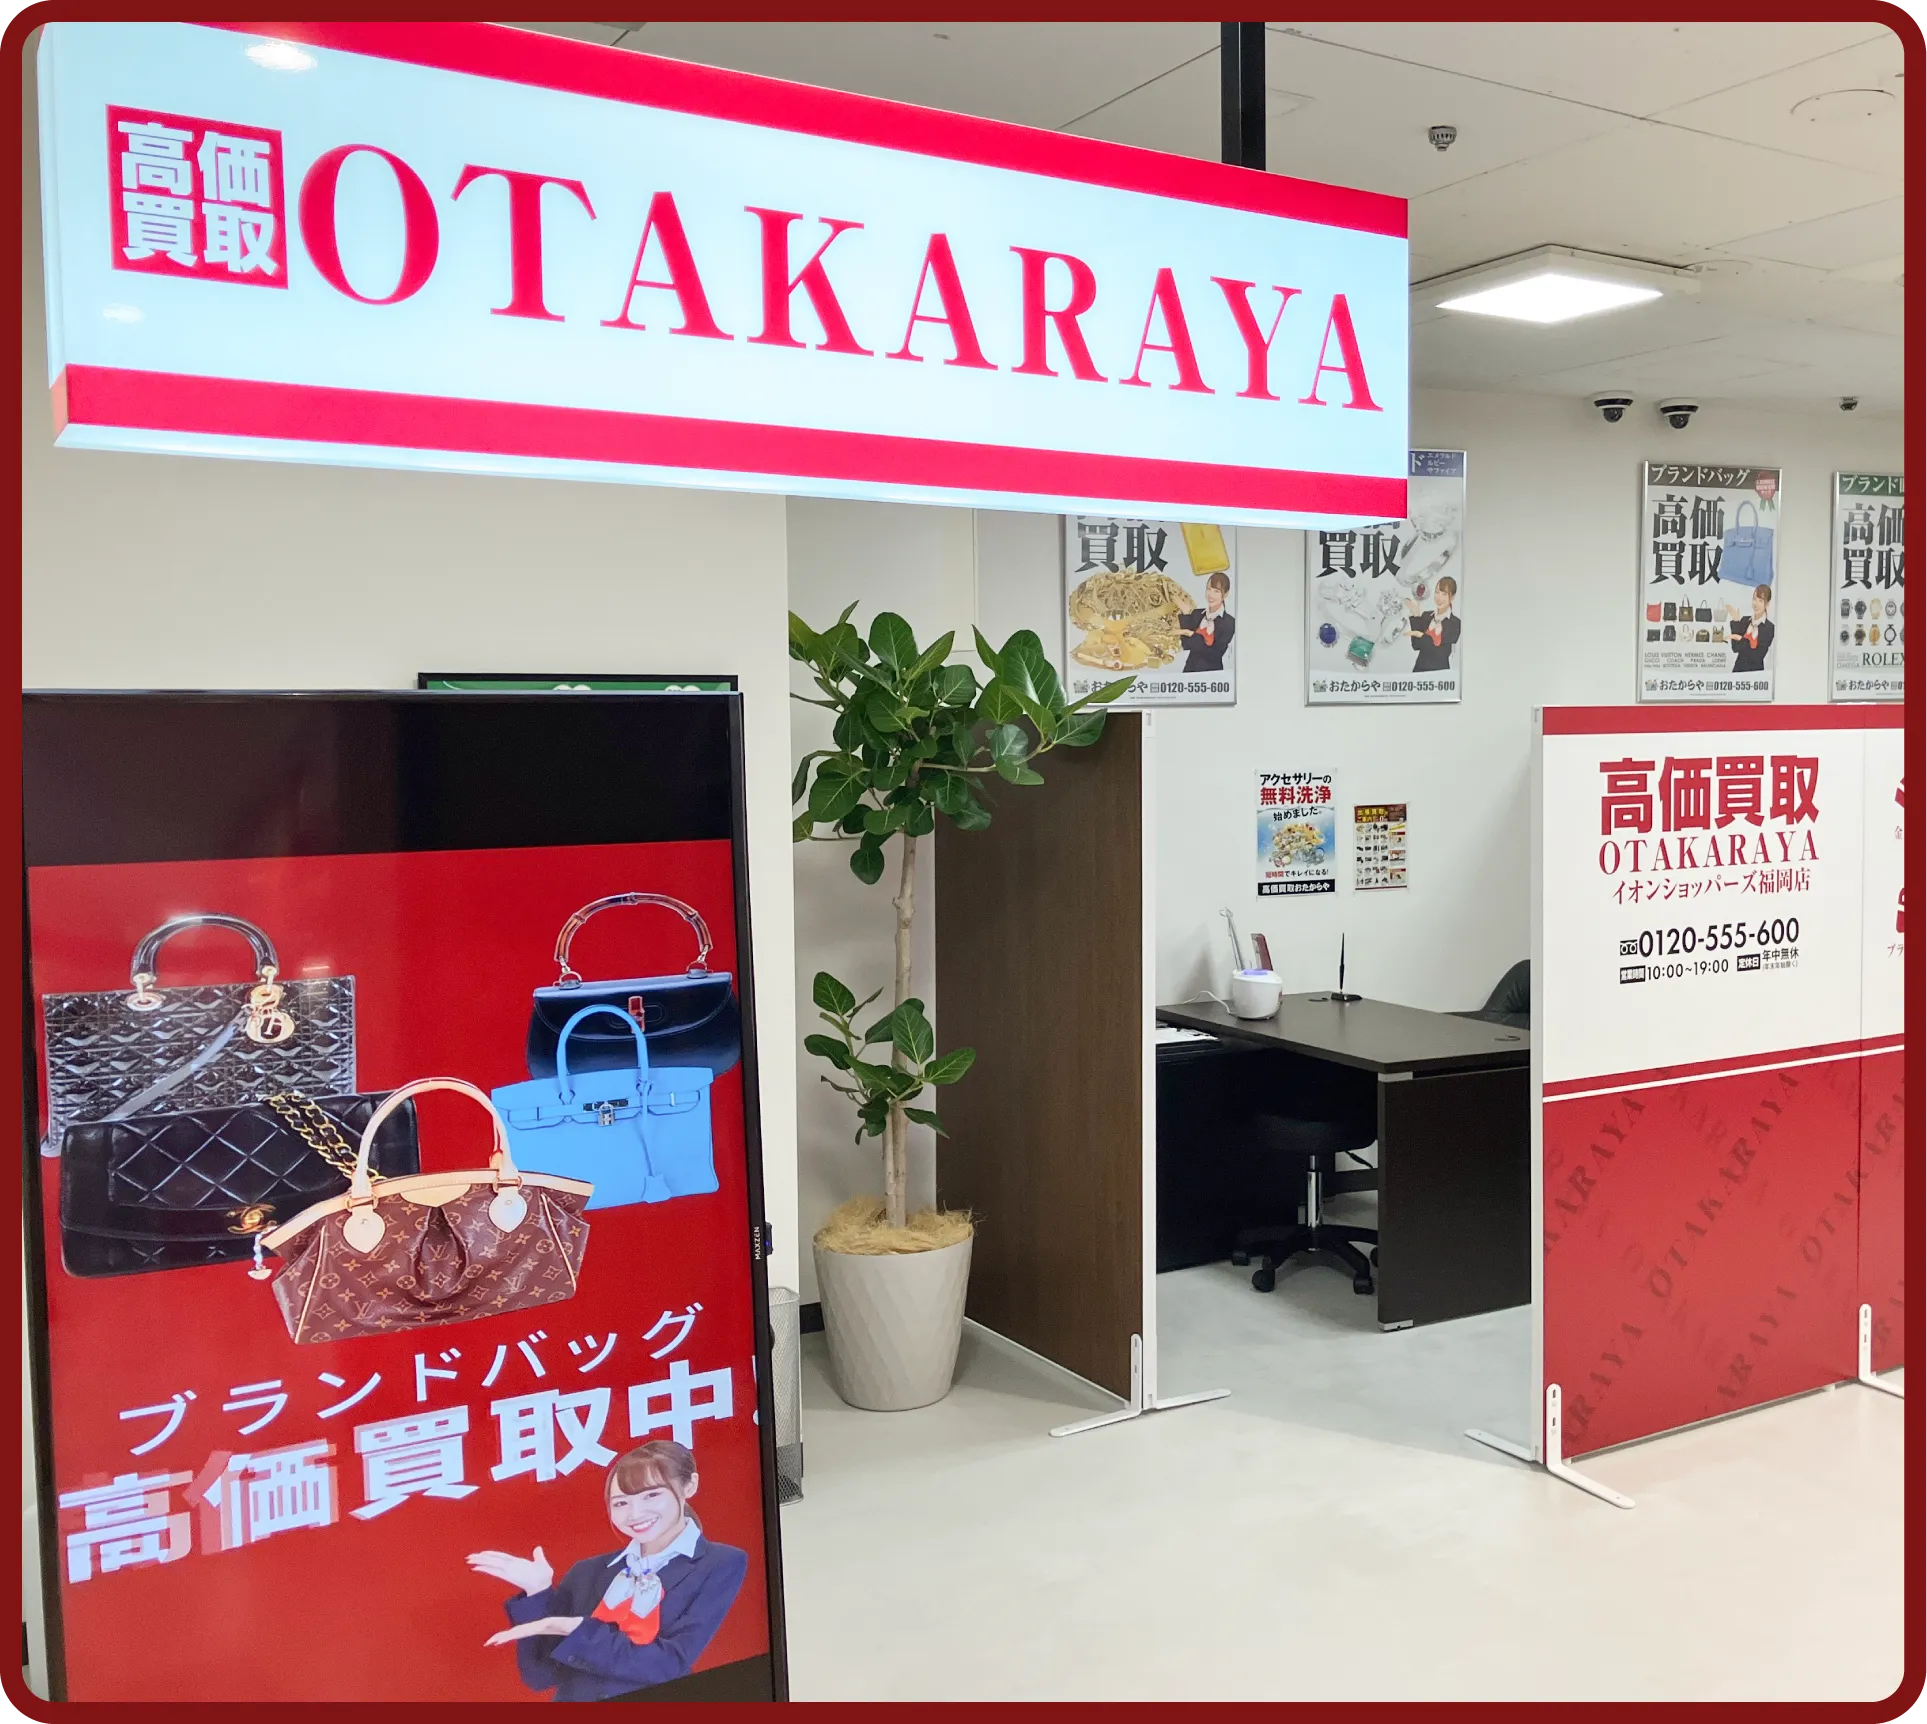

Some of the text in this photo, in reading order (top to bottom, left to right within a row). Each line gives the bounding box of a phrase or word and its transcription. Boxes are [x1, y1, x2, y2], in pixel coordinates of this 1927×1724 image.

[117, 121, 271, 208] 高価
[122, 194, 280, 277] 買取
[299, 143, 1384, 412] OTAKARAYA
[1650, 465, 1750, 486] ブランドバッグ
[1842, 474, 1904, 494] ブランド
[1652, 494, 1726, 540] 高価
[1842, 502, 1904, 547] 高価
[1074, 522, 1168, 573] 買取
[1316, 530, 1401, 579] 買取
[1650, 540, 1724, 585] 買取
[1840, 547, 1904, 590] 買取
[1160, 682, 1230, 693] 0120-555-600
[1329, 680, 1456, 692] おたからや 0120-555-600
[1660, 680, 1769, 691] おたからや 0120-555-600
[1848, 680, 1890, 691] おたからや
[1260, 772, 1332, 786] アクセサリーの
[1260, 785, 1332, 806] 無料洗浄
[1599, 754, 1820, 835] 高価買取
[1598, 829, 1820, 875] OTAKARAYA
[1262, 882, 1330, 894] 高価買取おたからや
[1611, 866, 1811, 905] イオンショッパーズ福岡店
[1638, 917, 1800, 958] 0120-555-600
[1762, 946, 1799, 962] 年中無休
[753, 1226, 762, 1260] MAXZEN
[119, 1302, 706, 1455] ブランドバッグ
